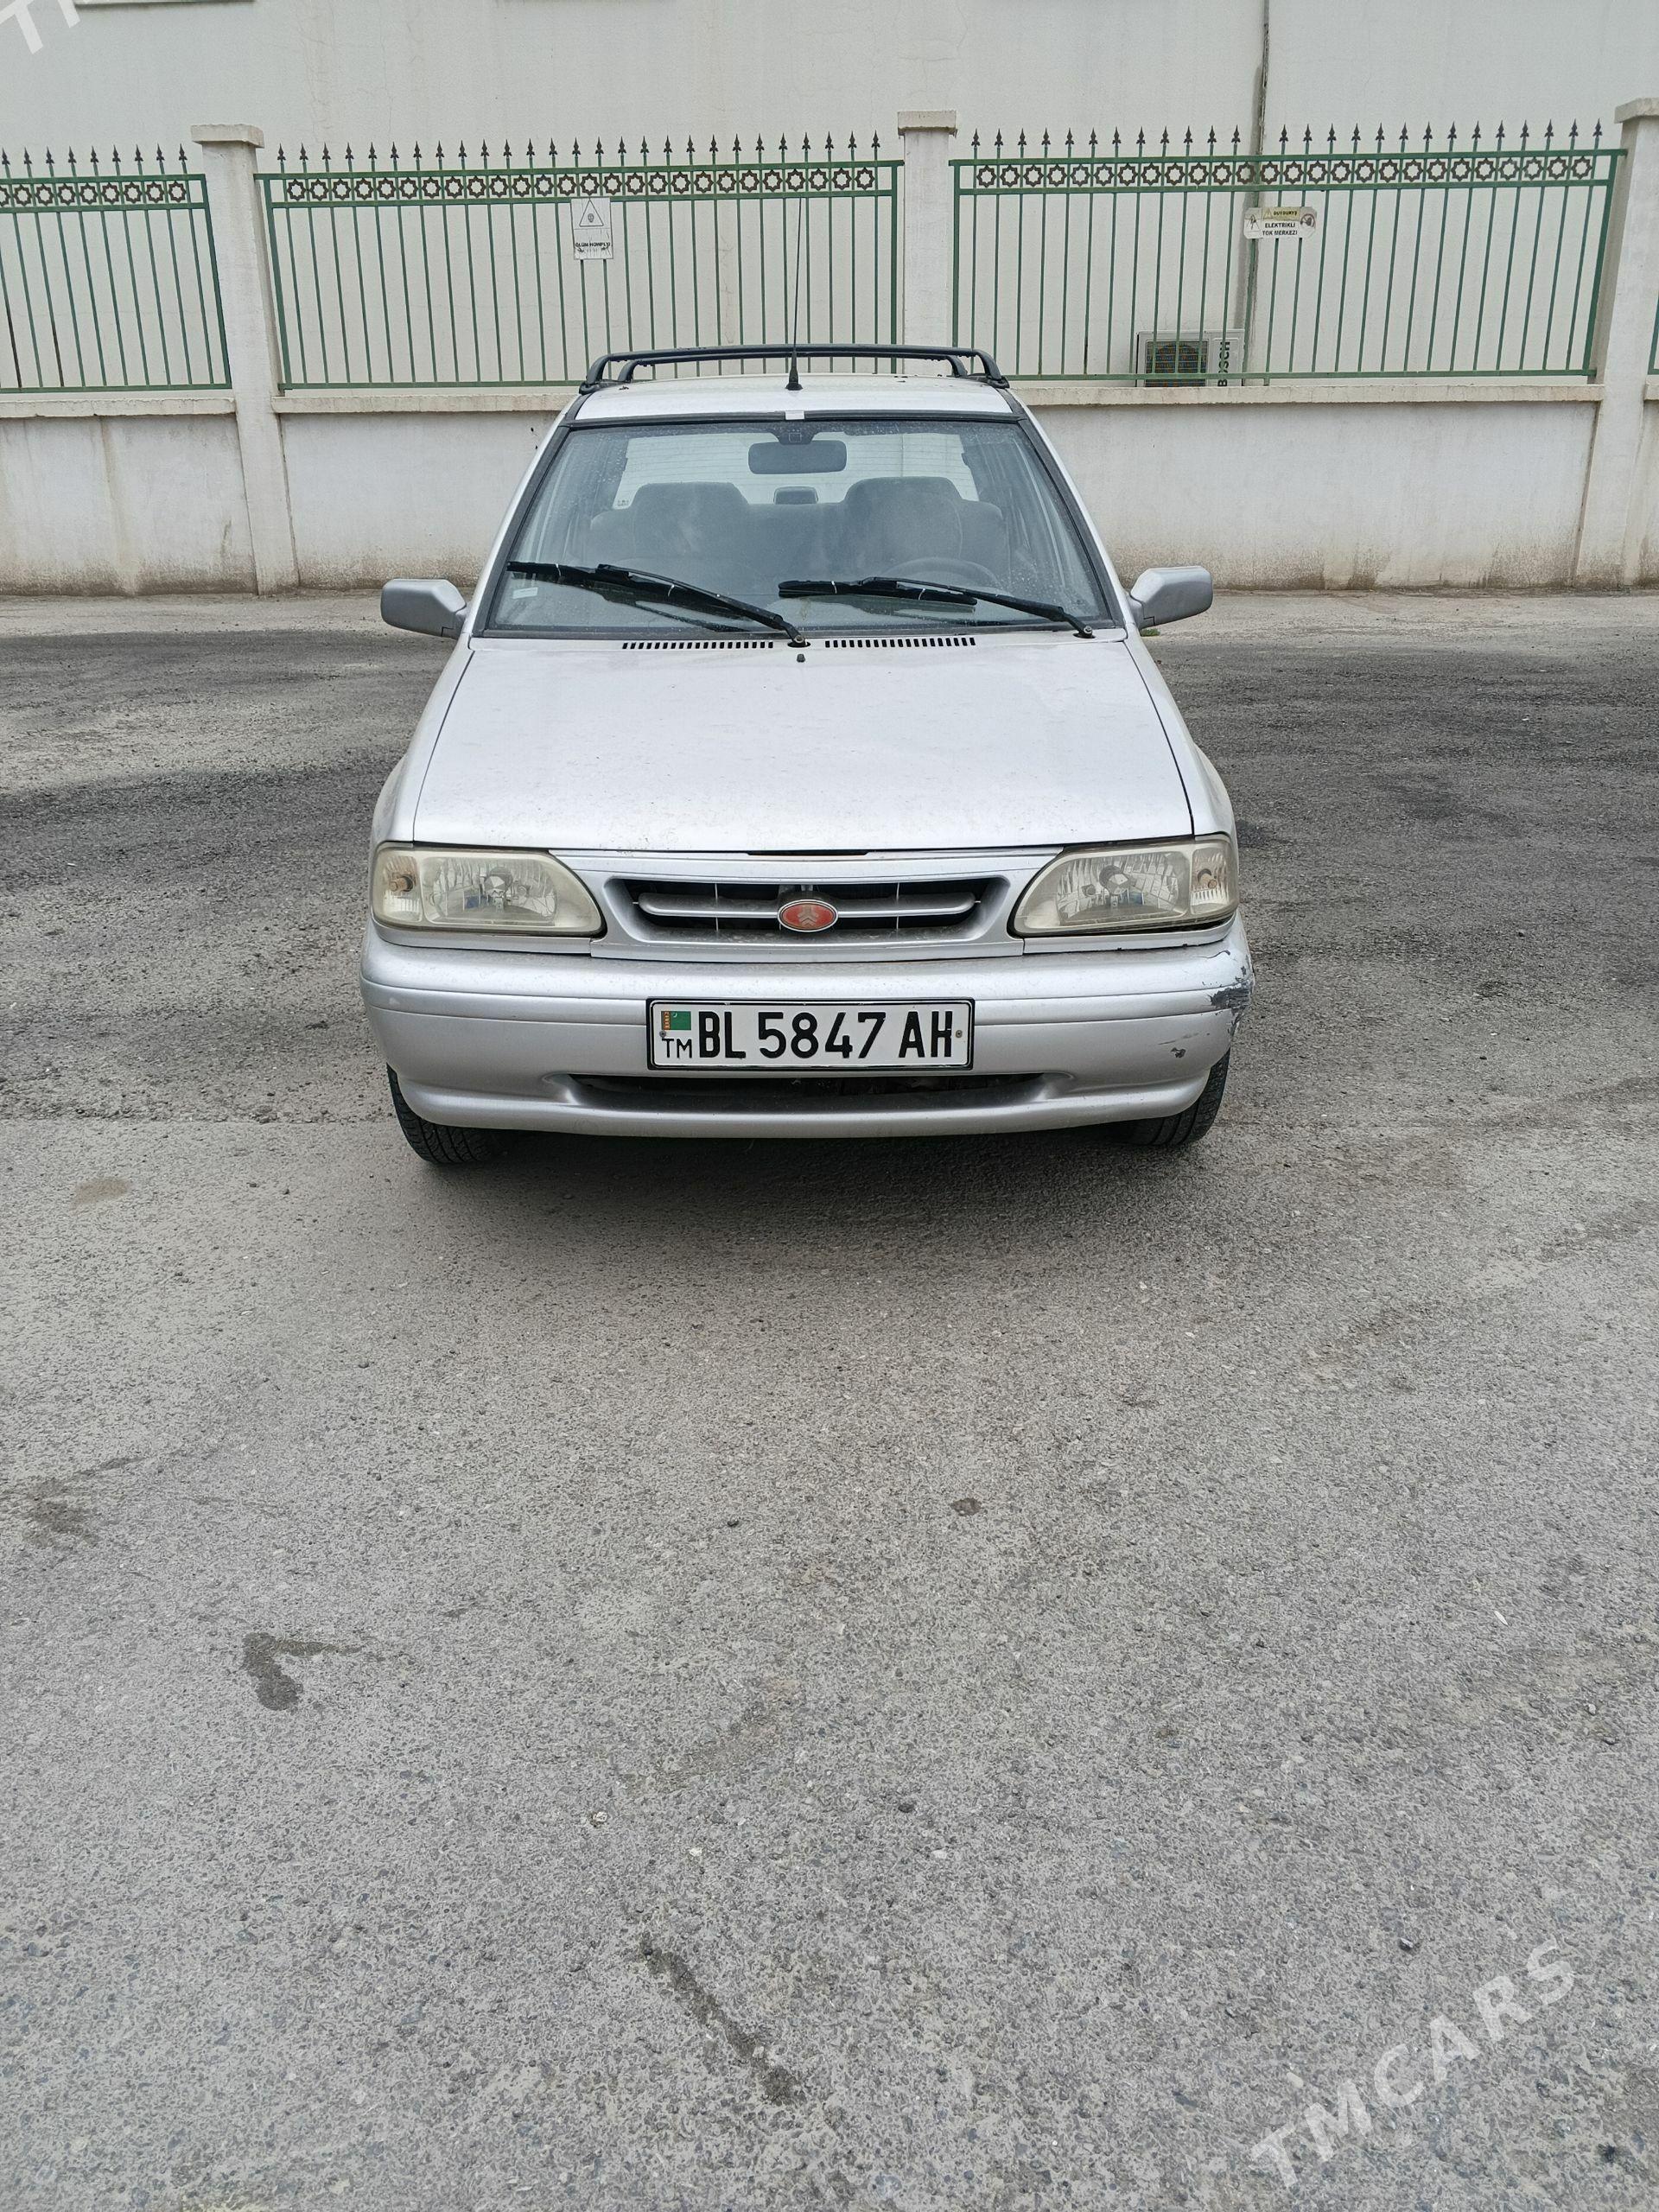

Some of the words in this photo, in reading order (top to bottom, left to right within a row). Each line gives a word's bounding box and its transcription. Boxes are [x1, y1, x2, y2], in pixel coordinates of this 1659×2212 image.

[662, 1038, 693, 1059] TM
[698, 1011, 747, 1059] BL
[758, 1012, 887, 1059] 5847
[898, 1011, 953, 1058] AH
